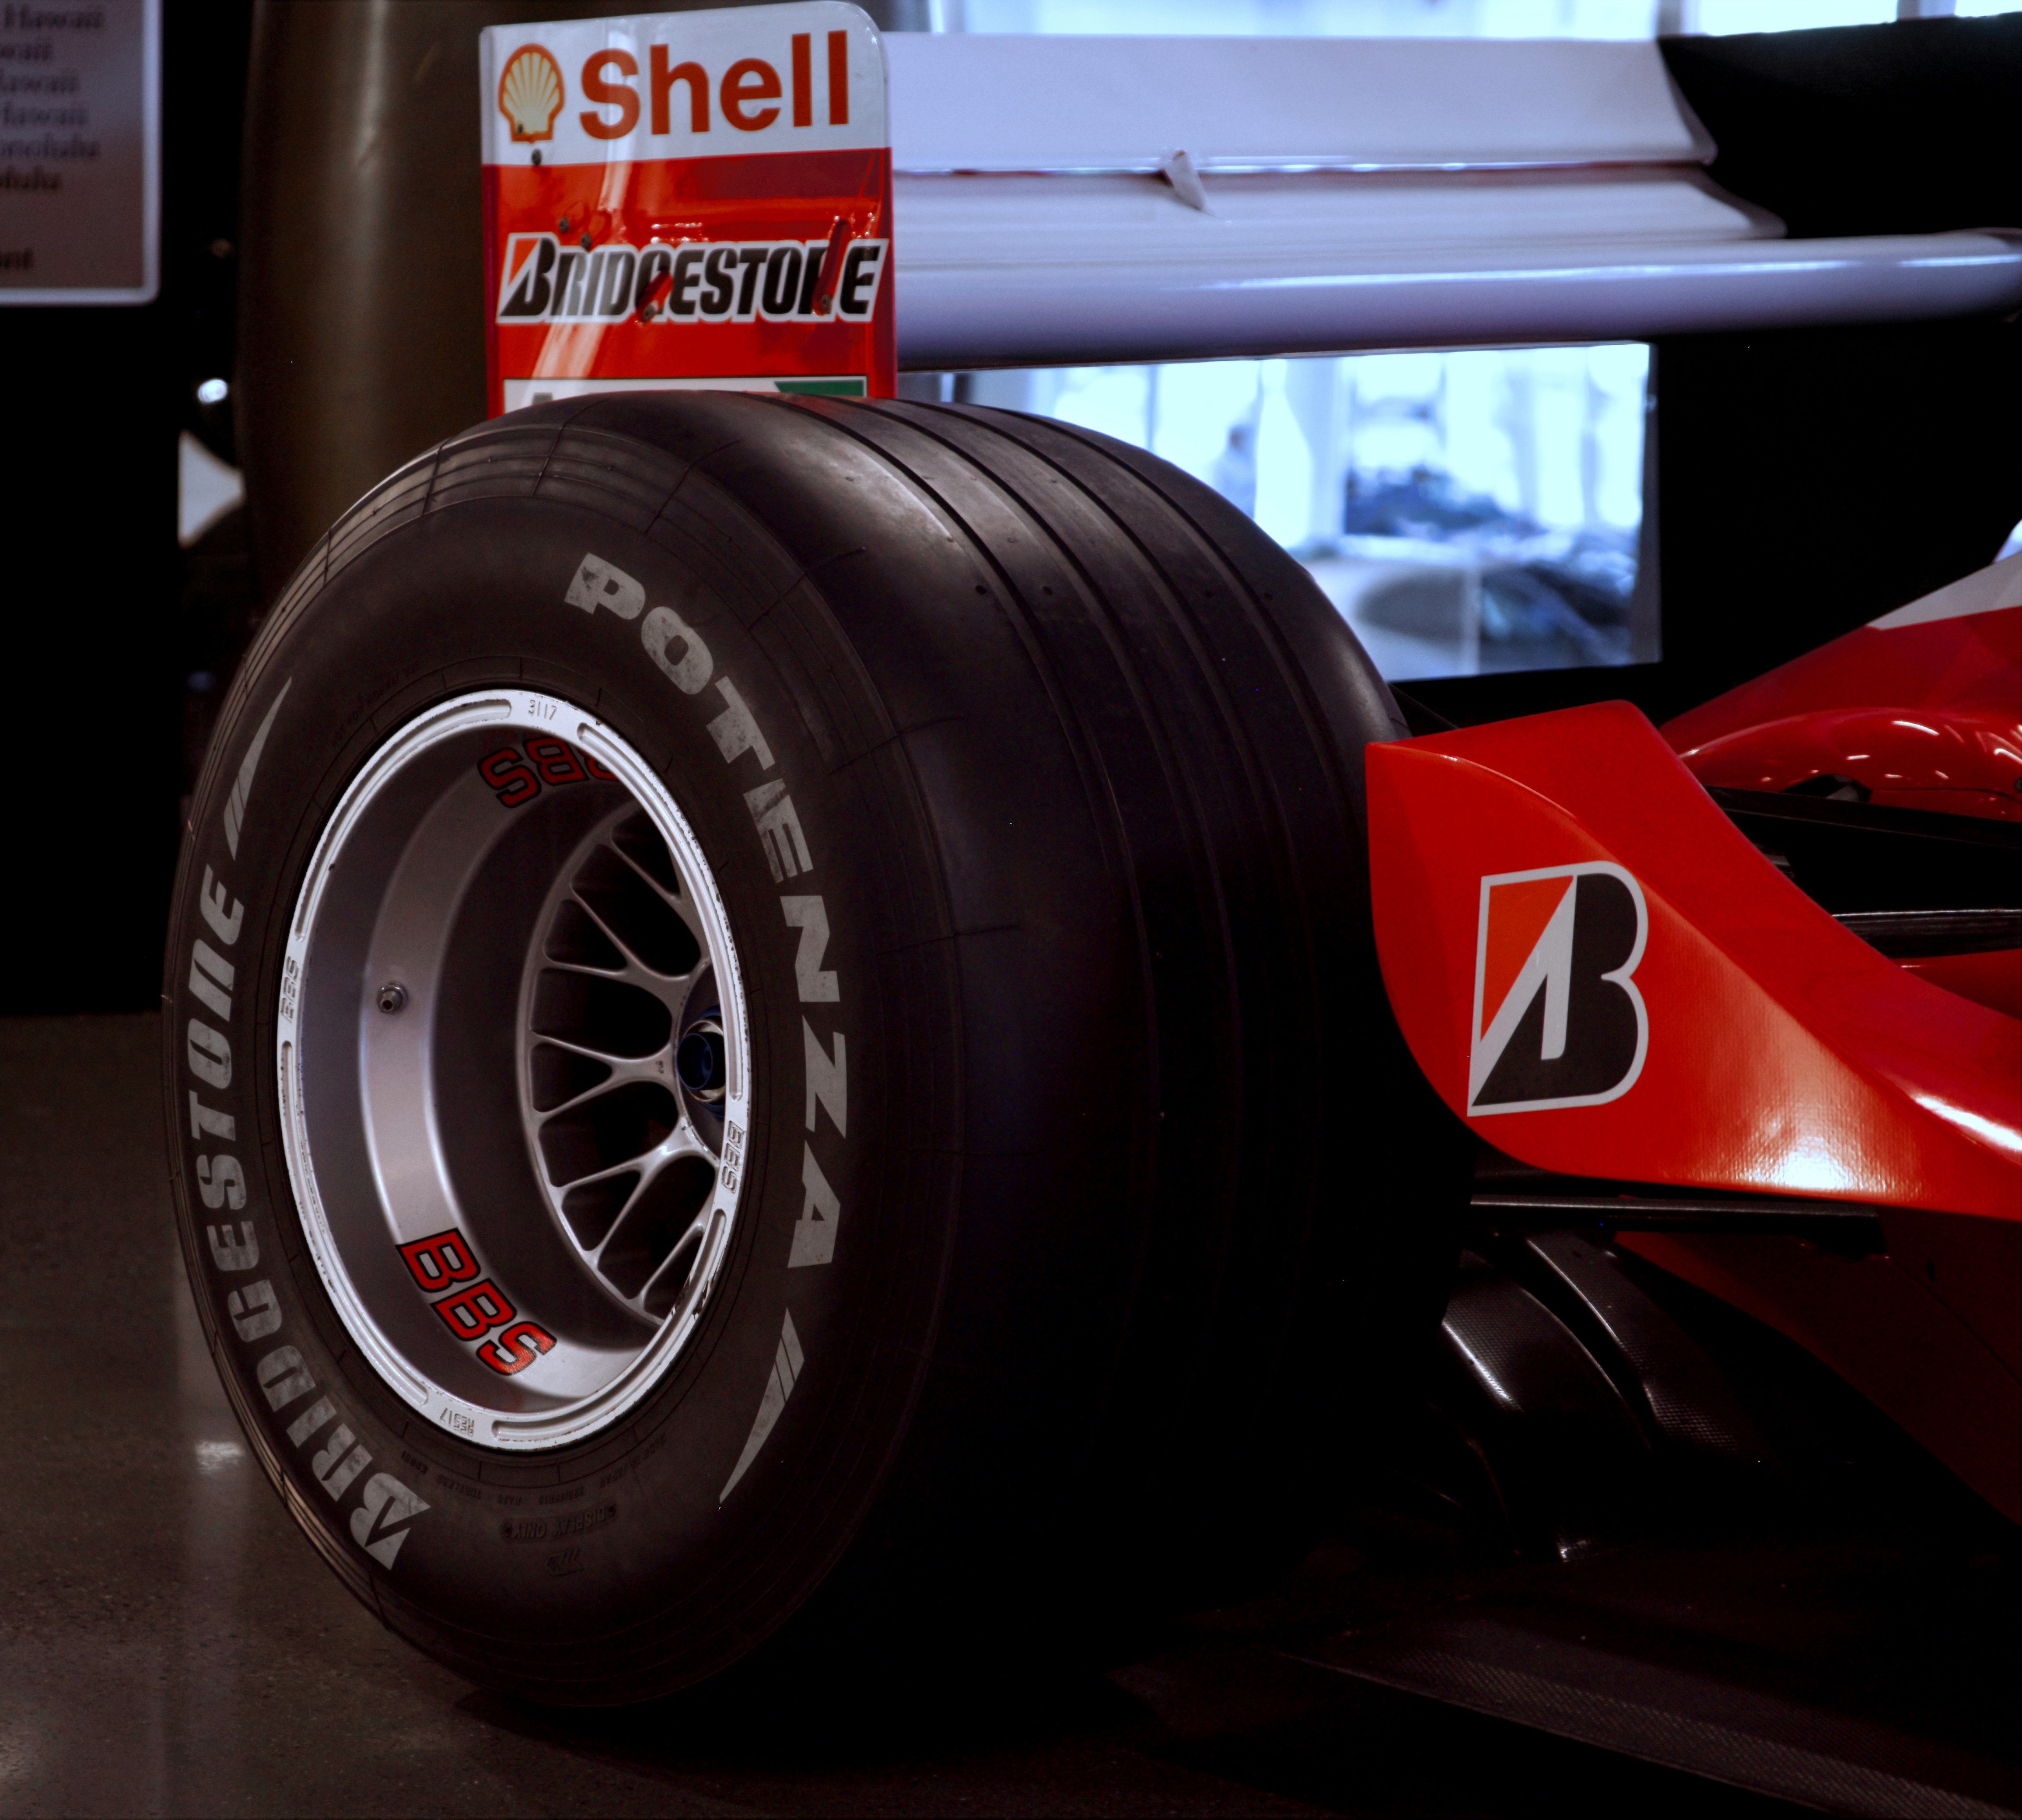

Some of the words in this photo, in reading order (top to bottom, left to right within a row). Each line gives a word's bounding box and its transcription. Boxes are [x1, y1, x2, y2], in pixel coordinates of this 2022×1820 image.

[4, 4, 103, 29] Hawaii
[579, 30, 849, 140] Shell
[528, 700, 557, 721] 3117
[564, 553, 847, 1268] POTENZA
[280, 956, 299, 1023] BBS
[721, 1120, 744, 1194] BBS
[187, 863, 431, 1571] BRIDGESTONE
[396, 1228, 557, 1375] BBS
[436, 1474, 482, 1499] TUBELESS
[513, 1522, 547, 1538] ONLY
[553, 1505, 606, 1537] DISPLAY
